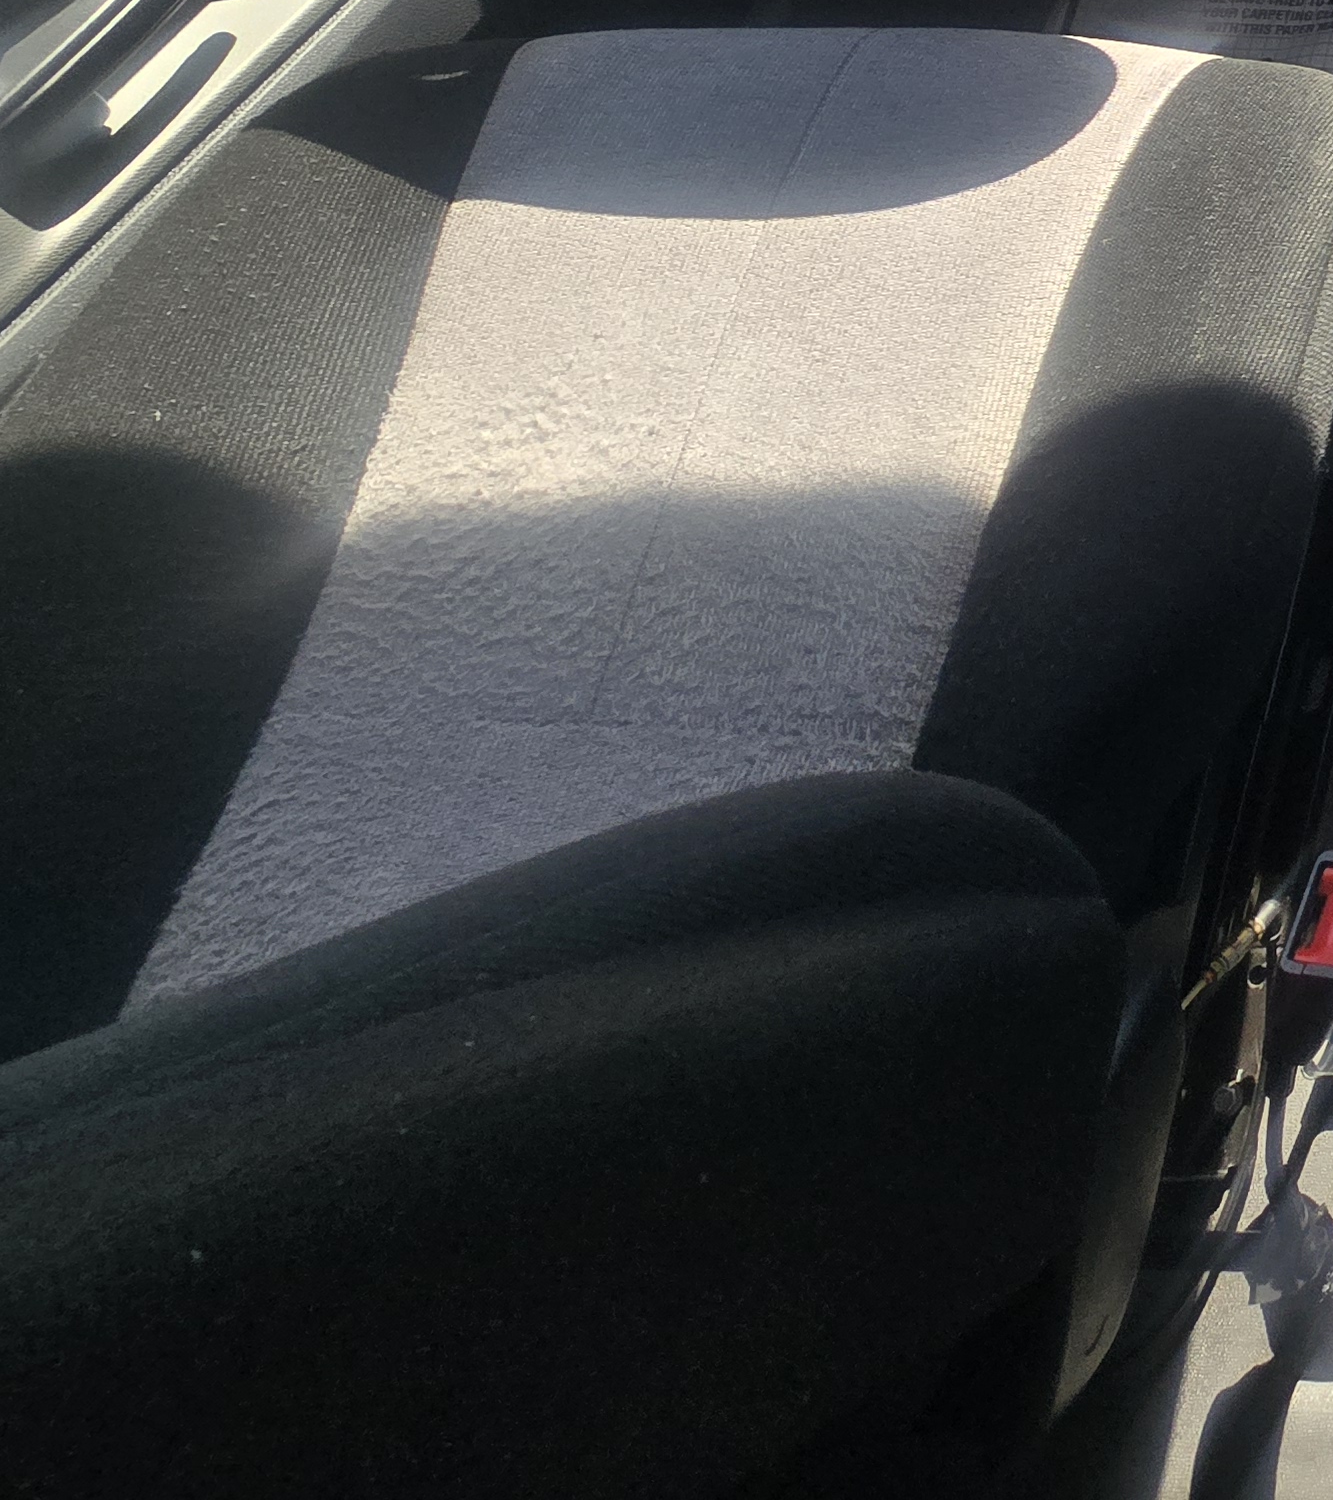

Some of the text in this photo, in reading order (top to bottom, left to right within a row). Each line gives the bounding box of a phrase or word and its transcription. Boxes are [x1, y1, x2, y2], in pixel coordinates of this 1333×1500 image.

[1241, 8, 1313, 21] CARPETING
[1241, 22, 1271, 35] THIS
[1275, 23, 1315, 35] PAPER
